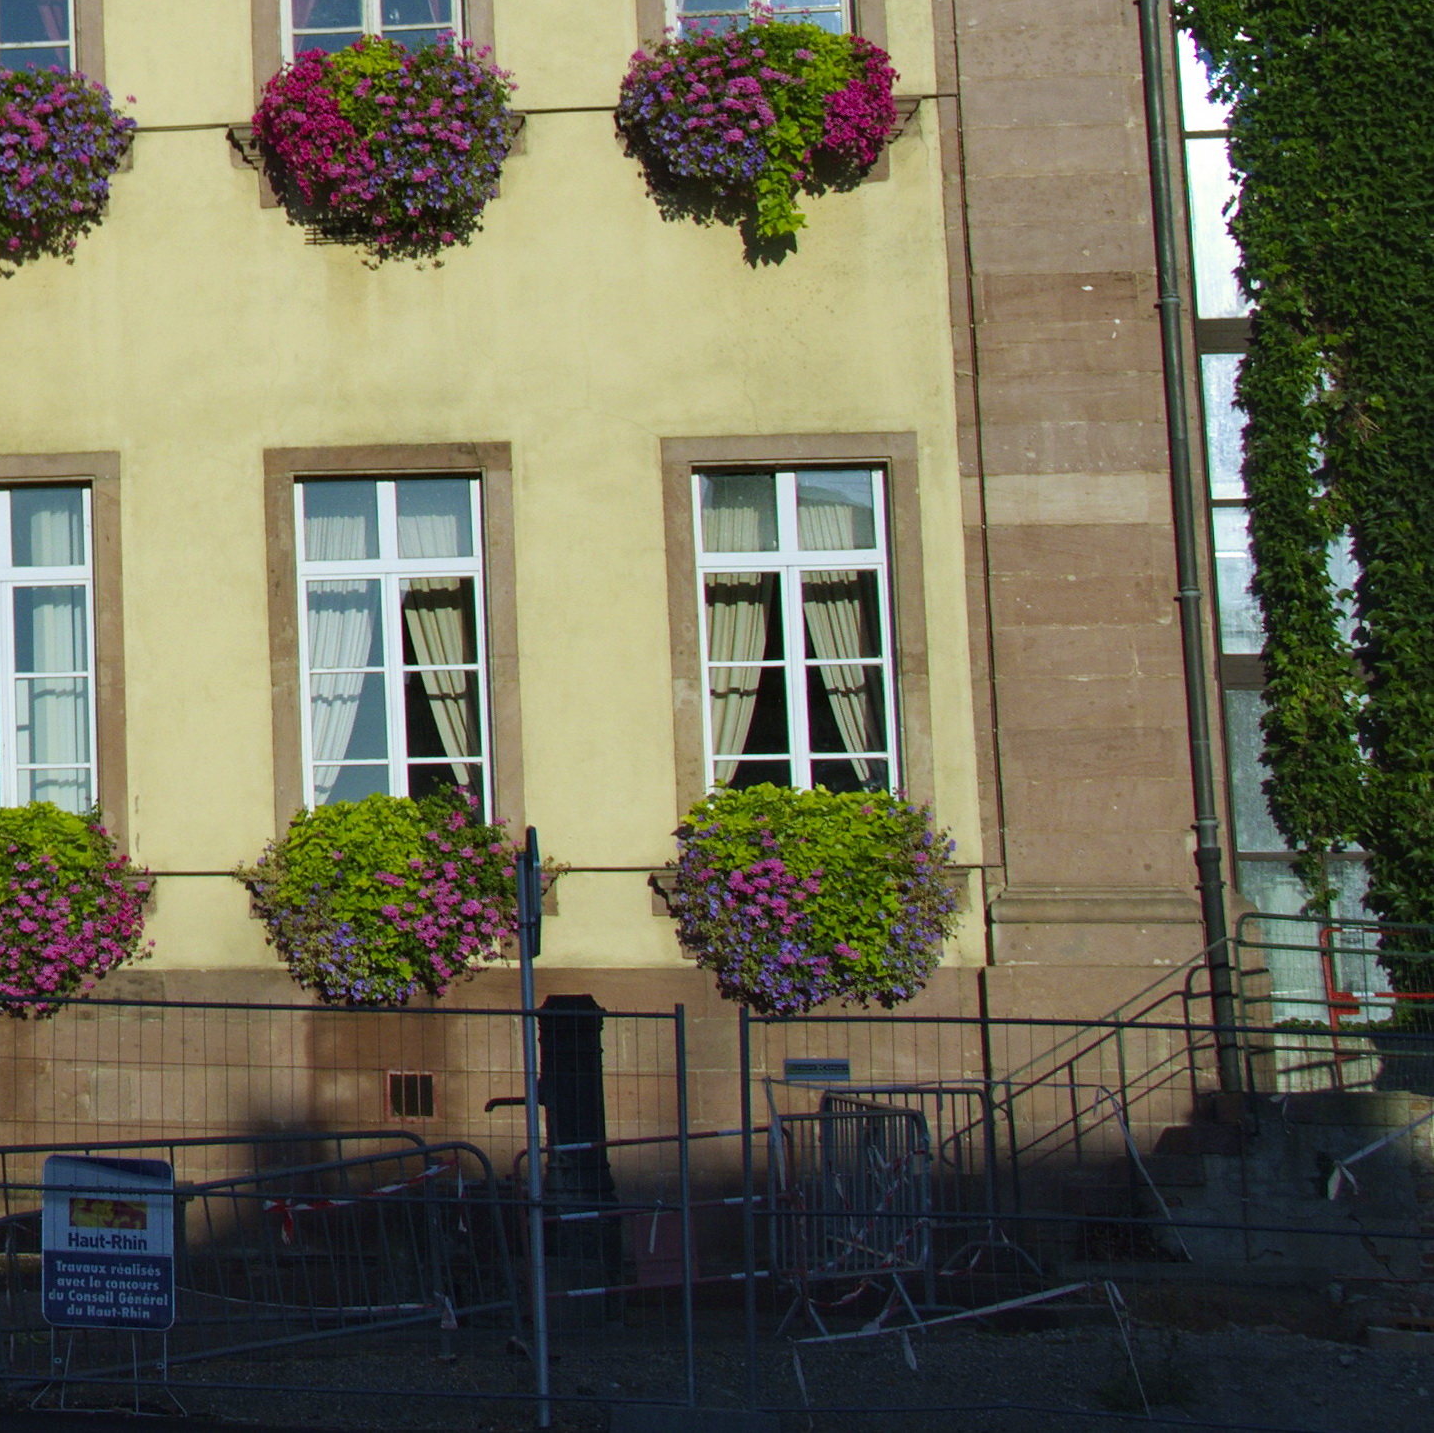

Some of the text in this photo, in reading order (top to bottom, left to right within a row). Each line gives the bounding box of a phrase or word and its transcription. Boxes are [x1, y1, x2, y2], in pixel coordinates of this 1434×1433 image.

[68, 1233, 147, 1250] Haut-Rhin
[56, 1260, 161, 1276] Travaux réalisés
[57, 1275, 159, 1291] avec le concours
[48, 1289, 168, 1306] du Conseil Général
[67, 1304, 150, 1319] du Haut-Rhin
